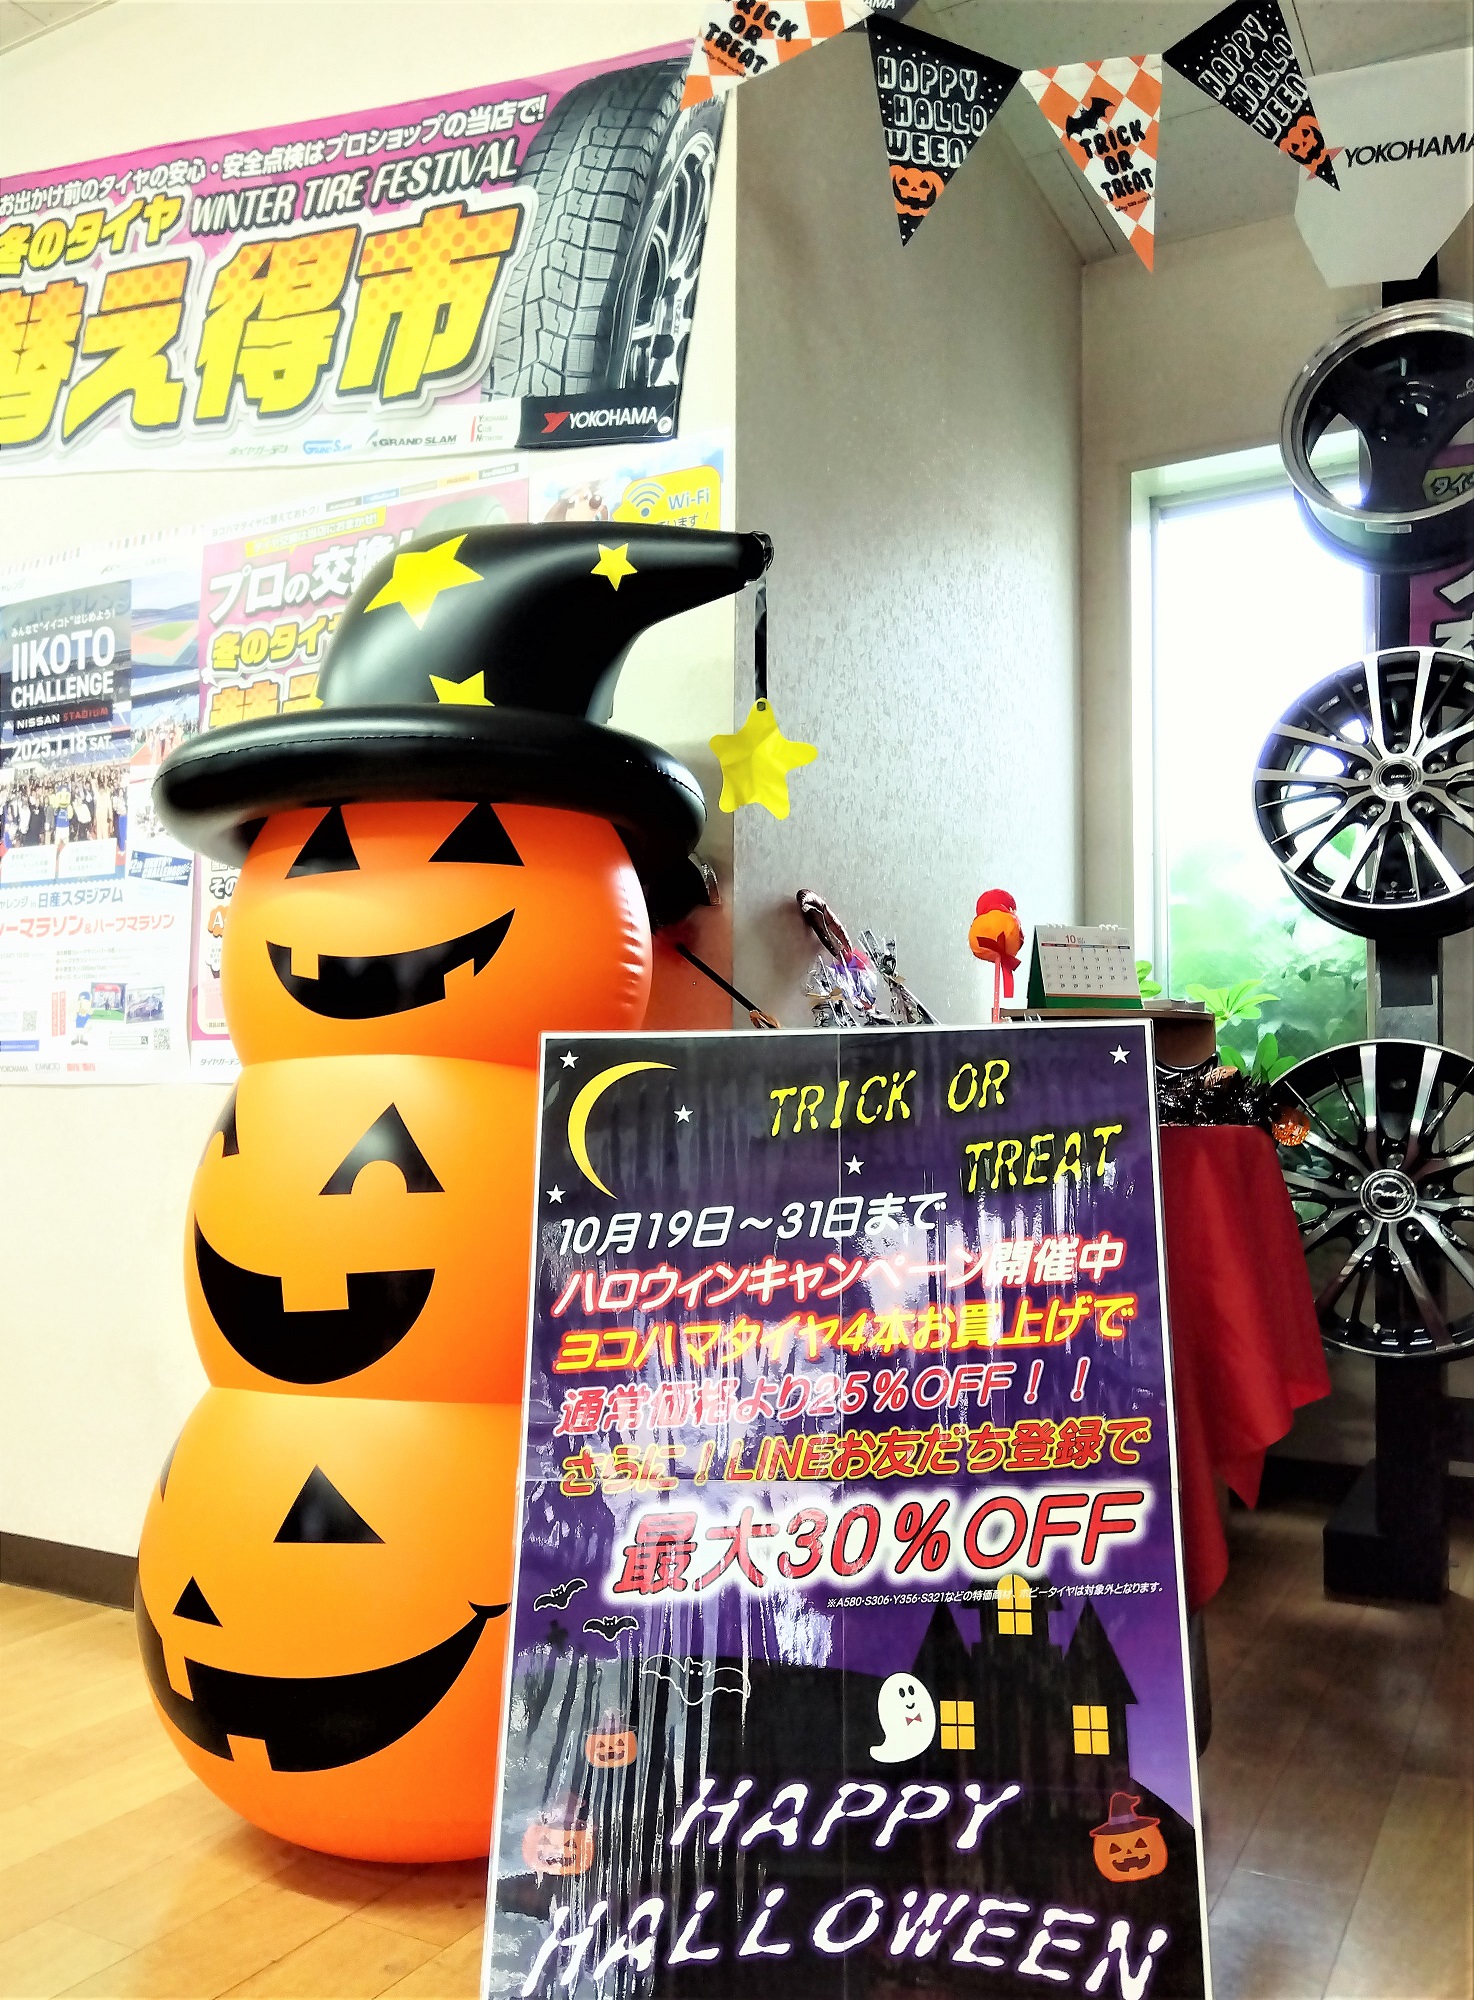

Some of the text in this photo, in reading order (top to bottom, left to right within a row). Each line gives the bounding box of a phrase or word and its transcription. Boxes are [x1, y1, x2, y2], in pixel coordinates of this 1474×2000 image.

[724, 0, 799, 42] RICK
[729, 14, 763, 46] OR
[705, 22, 768, 75] TREAT
[1198, 14, 1269, 101] HAPPY
[877, 55, 978, 102] HAPPY
[1231, 33, 1296, 115] HALLO
[893, 94, 988, 137] HALLO
[1251, 73, 1309, 143] WEEN
[884, 127, 967, 169] WEEN
[1079, 119, 1147, 160] TRICK
[1104, 150, 1134, 176] OR
[190, 137, 519, 234] WINTER TIRE FESTIVAL
[1100, 168, 1154, 202] TREAT
[569, 406, 659, 429] YOKOHAMA
[378, 434, 458, 447] GRAND SLAM
[668, 488, 711, 512] Wi-Fi
[12, 626, 116, 683] IIKOTO
[11, 671, 114, 709] CHALLENGE
[16, 707, 109, 730] NISSAN STADIUM
[11, 731, 87, 763] 2025.1.18
[37, 886, 124, 909] 日産スタジアム
[1065, 934, 1077, 944] 10
[769, 1058, 1011, 1137] TRICK OR
[964, 1124, 1123, 1195] TREAT
[558, 1190, 949, 1257] 10月19日～31日まで
[552, 1295, 1138, 1375] ヨコハマタイヤ4本お買上げで
[611, 1488, 1148, 1597] 最大30%OFF
[668, 1776, 1021, 1851] HAPPY
[520, 1885, 1170, 2000] HALLOWEEN
